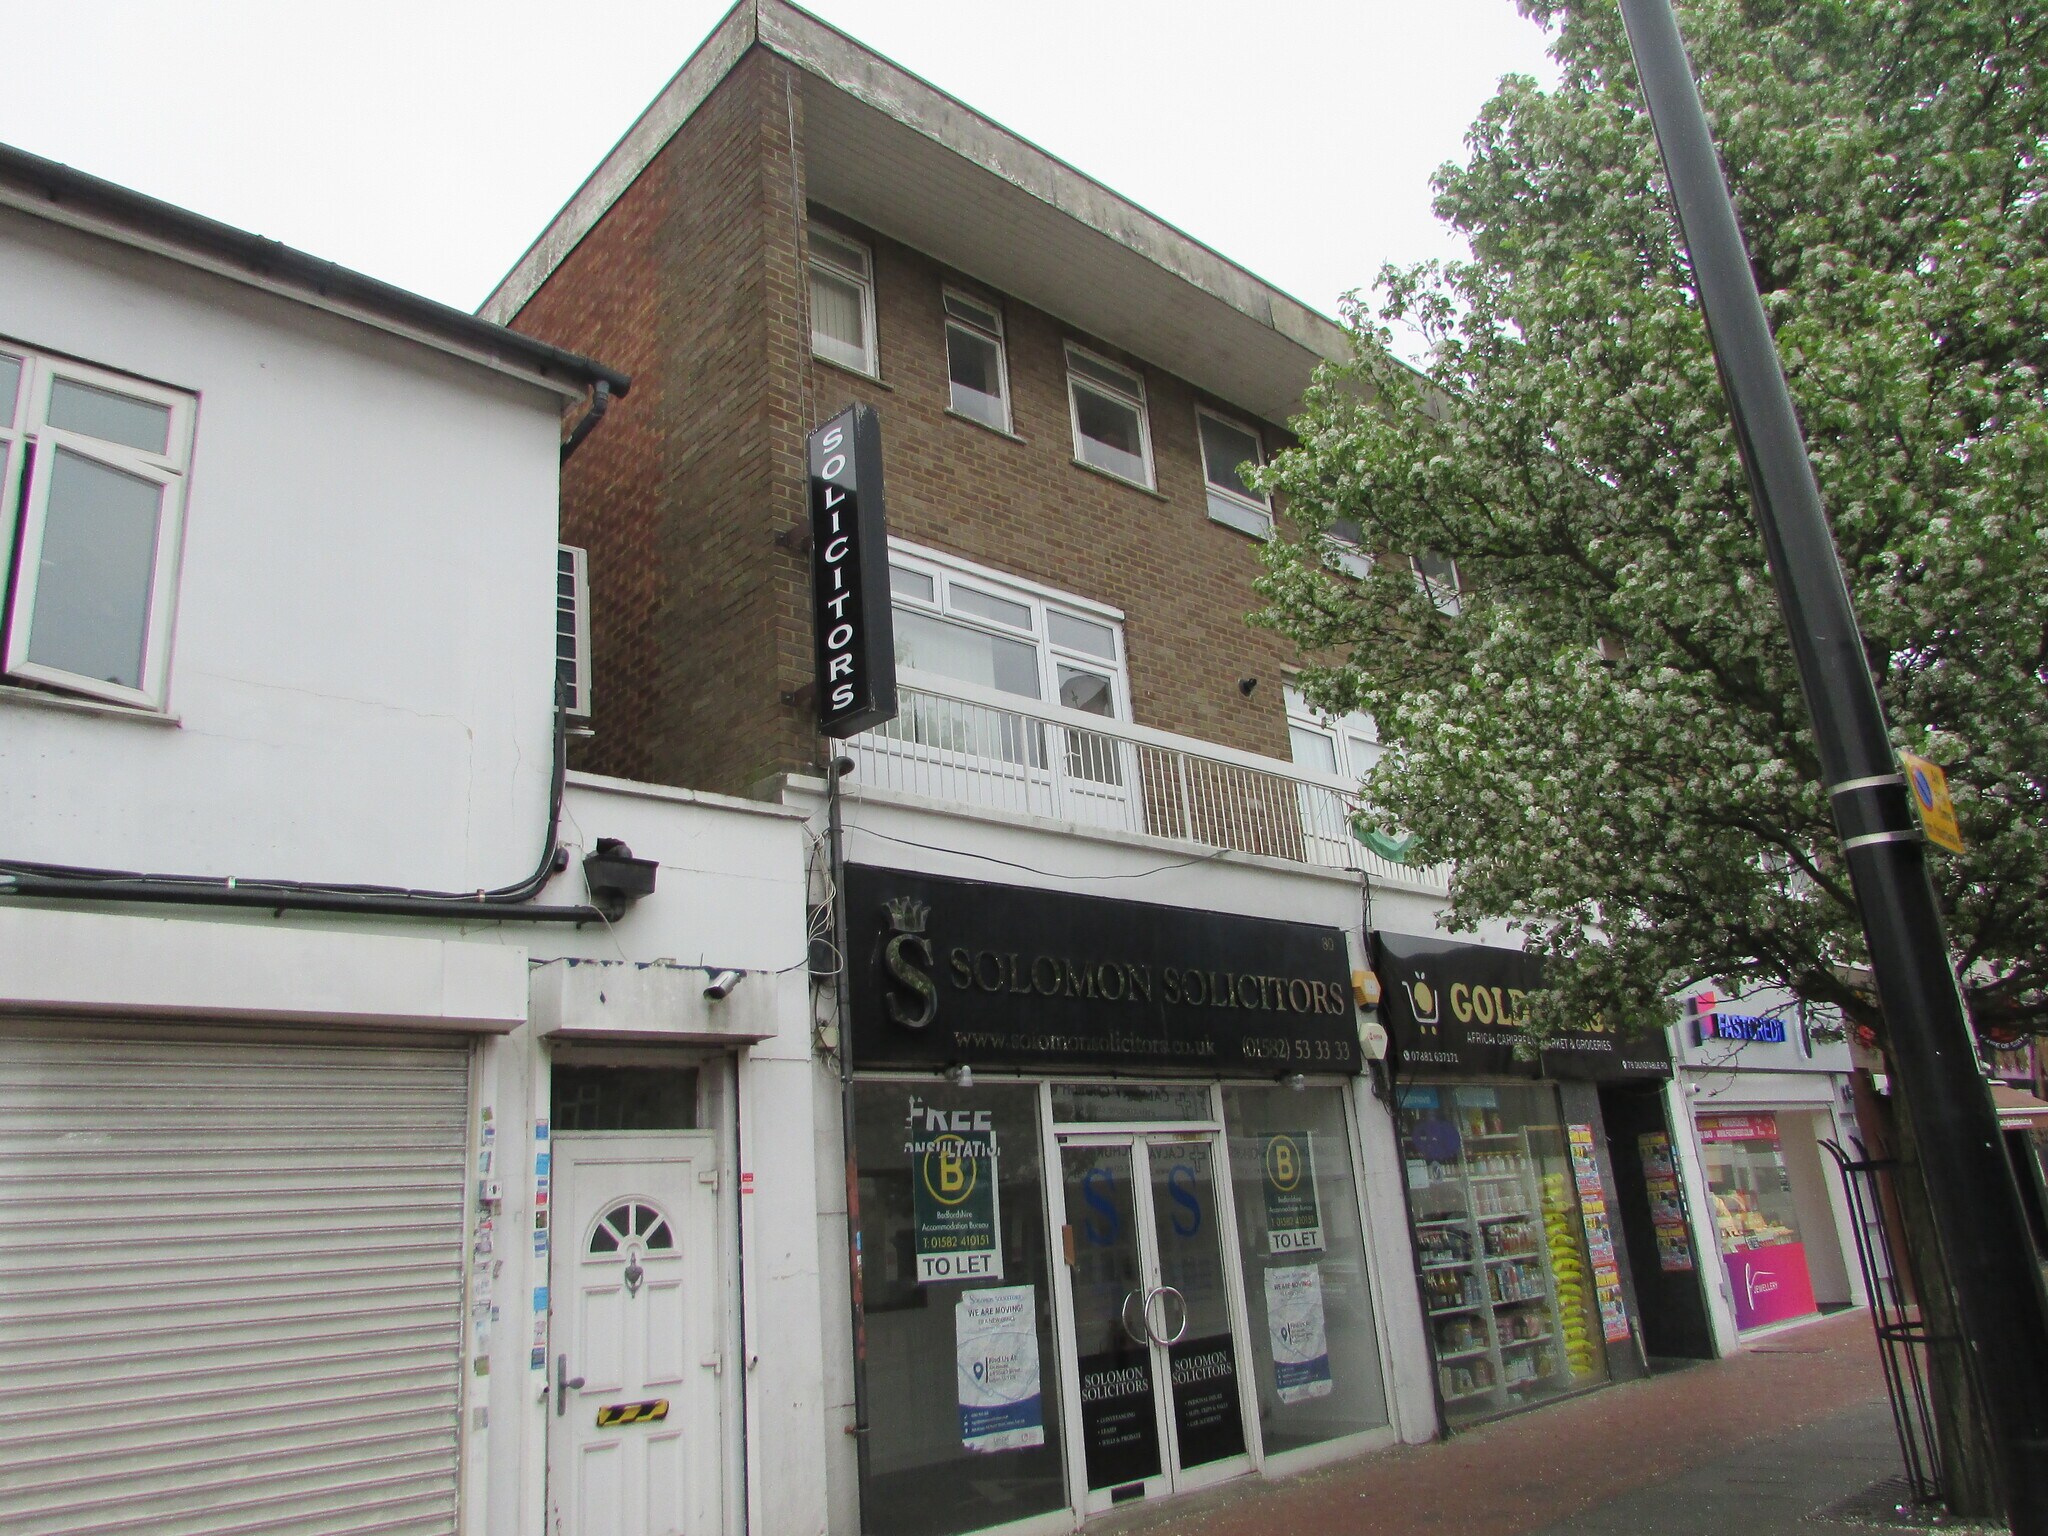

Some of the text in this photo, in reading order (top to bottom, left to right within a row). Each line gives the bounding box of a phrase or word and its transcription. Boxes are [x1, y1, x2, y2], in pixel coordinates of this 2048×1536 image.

[821, 426, 855, 711] SOLICITORS
[1321, 937, 1334, 951] 80
[951, 947, 1345, 1016] SOLOMON SOLICITORS
[1242, 1036, 1290, 1061] (01582)
[1295, 1039, 1311, 1059] 53
[1315, 1040, 1331, 1059] 33
[1334, 1041, 1350, 1060] 33
[940, 1151, 965, 1192] B
[1275, 1145, 1294, 1180] B
[1083, 1167, 1119, 1247] S
[1168, 1164, 1201, 1238] S
[931, 1236, 957, 1248] 01582
[961, 1234, 990, 1246] 410151
[1272, 1231, 1317, 1248] TO LET
[922, 1254, 991, 1276] TO LET
[968, 1309, 980, 1317] WE
[980, 1307, 994, 1316] ARE
[1175, 1350, 1227, 1372] SOLOMON
[1084, 1366, 1143, 1388] SOLOMON
[1172, 1362, 1232, 1385] SOLICITORS
[1081, 1378, 1149, 1402] SOLICITORS
